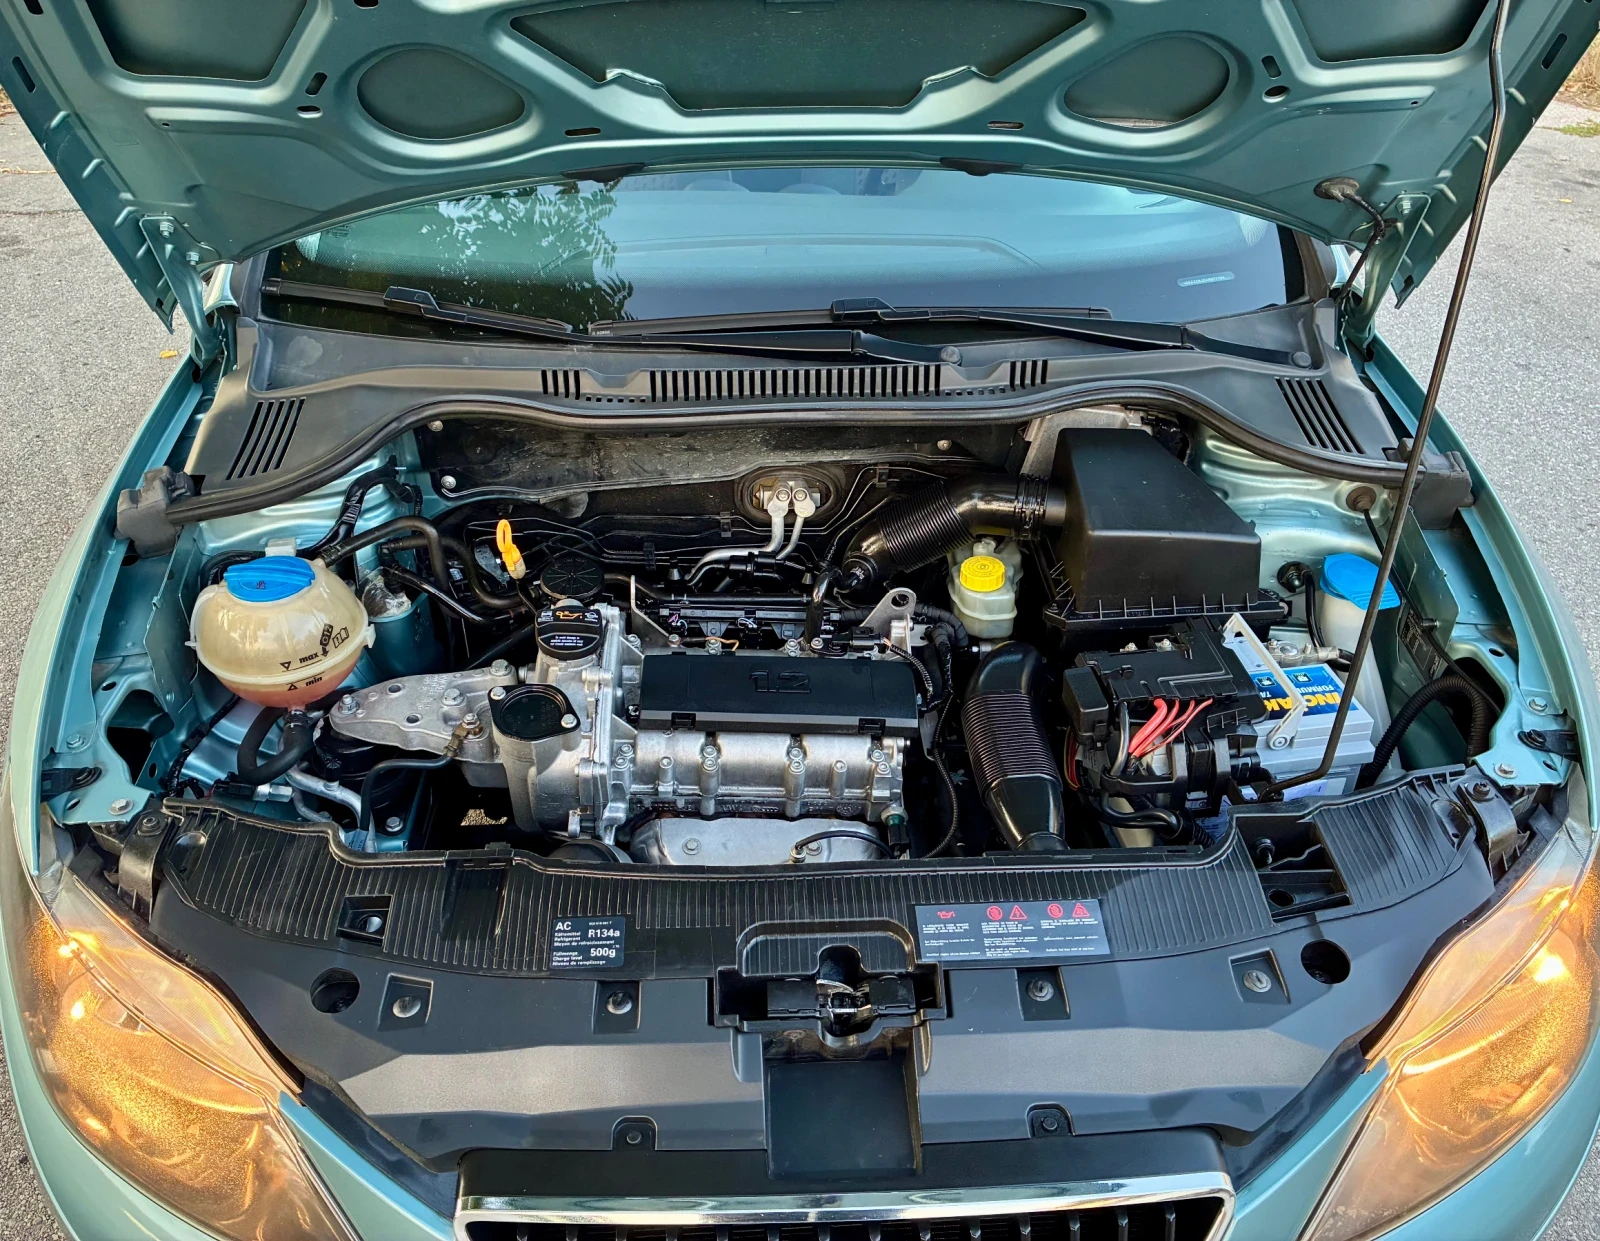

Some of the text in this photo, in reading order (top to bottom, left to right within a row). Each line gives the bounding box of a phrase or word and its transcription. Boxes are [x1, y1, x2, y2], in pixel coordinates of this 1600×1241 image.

[298, 652, 320, 664] max
[305, 676, 323, 687] min
[749, 669, 812, 694] 1.2
[1295, 684, 1335, 694] FORMUL
[1264, 697, 1293, 711] AK
[555, 921, 572, 931] AC
[588, 928, 620, 938] R134a
[590, 947, 616, 958] 500g
